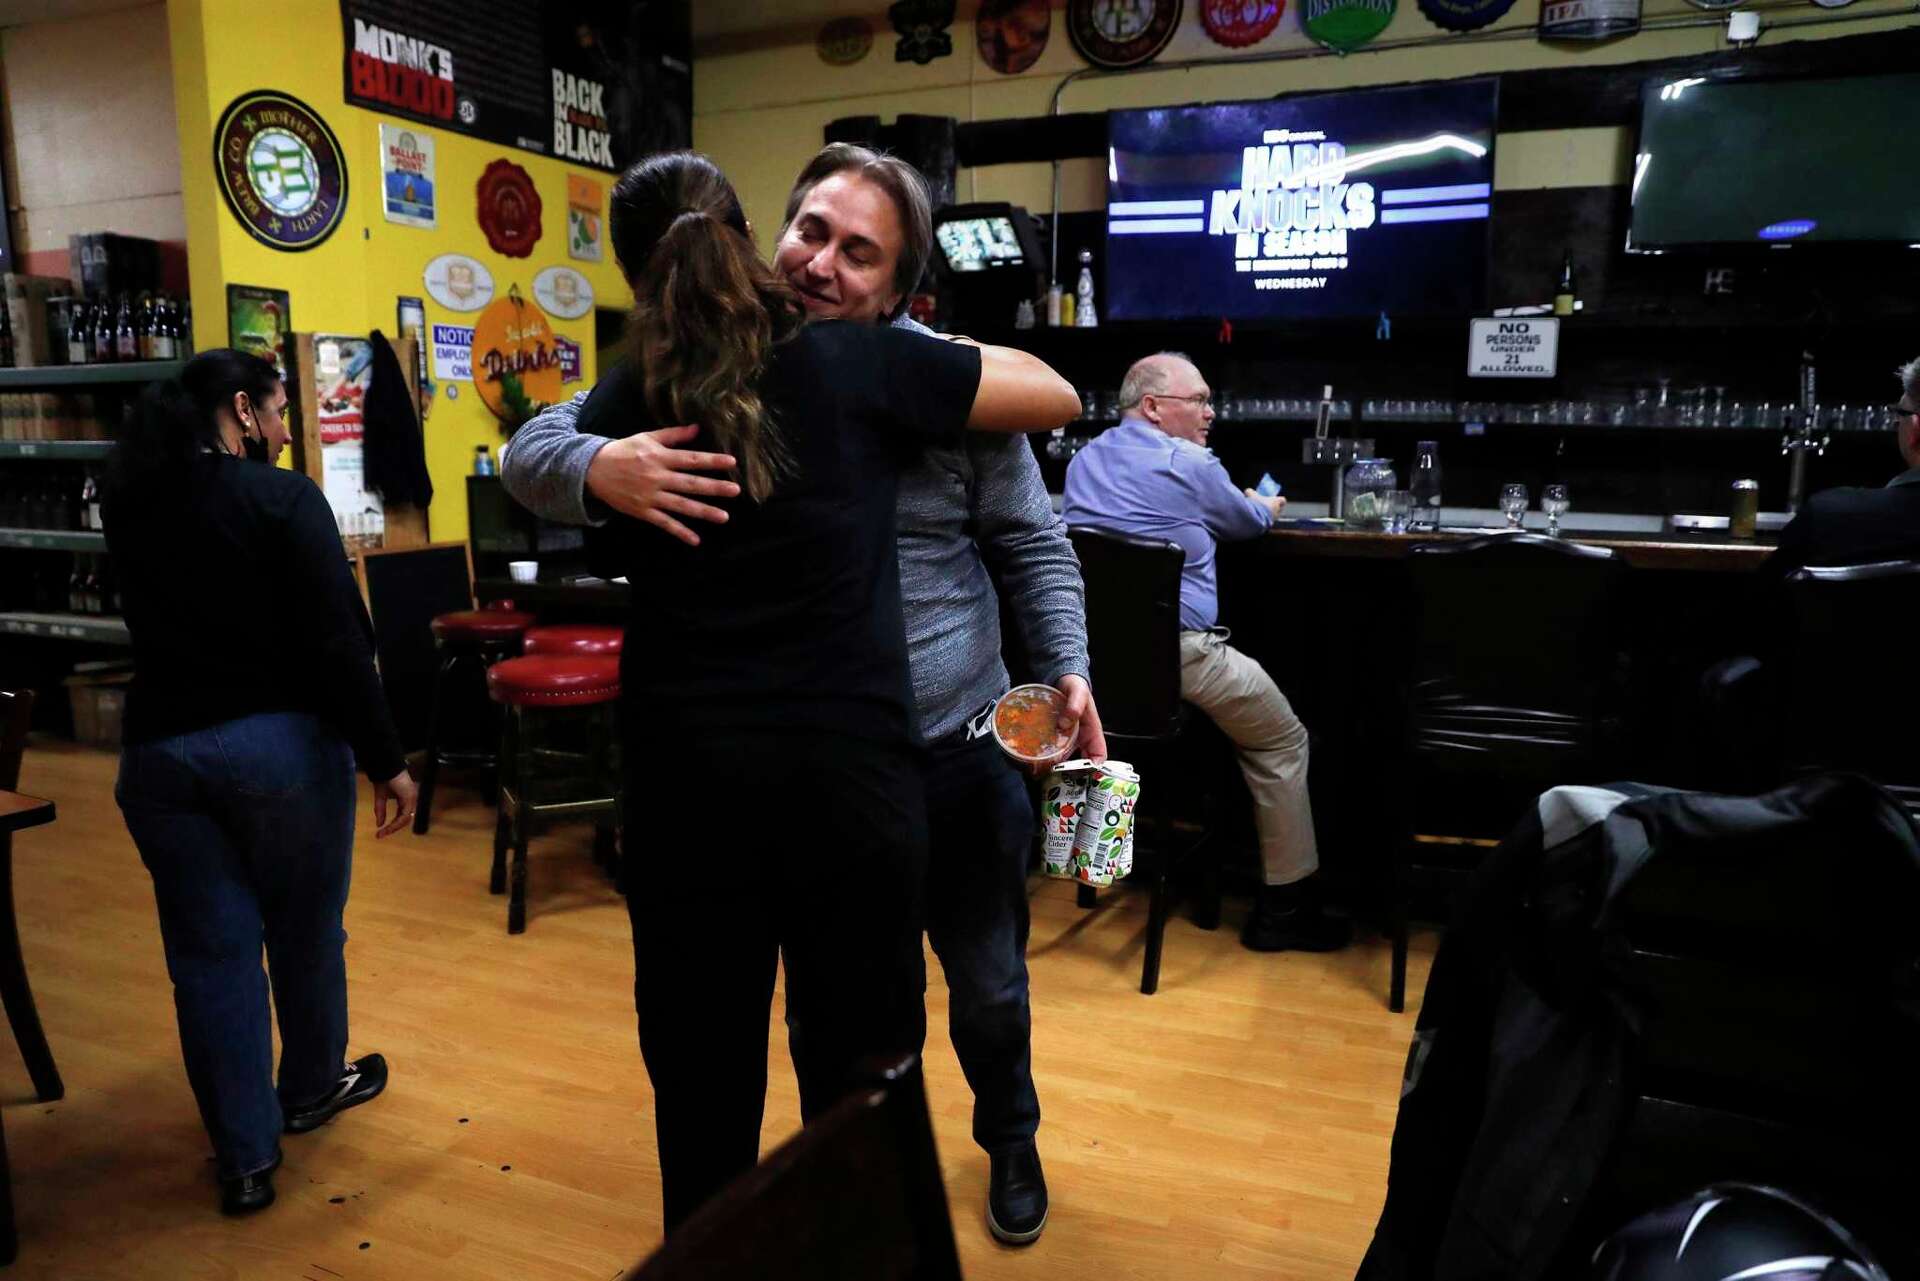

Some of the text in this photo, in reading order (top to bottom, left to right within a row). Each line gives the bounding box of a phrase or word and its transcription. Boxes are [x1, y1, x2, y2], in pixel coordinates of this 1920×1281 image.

[351, 50, 455, 120] BLOOD
[552, 67, 606, 118] BACK
[553, 101, 569, 123] IN
[553, 118, 615, 168] BLACK
[258, 109, 319, 145] MOTHER
[290, 198, 329, 233] EARTH
[1241, 142, 1346, 191] HARD
[231, 169, 261, 217] BREW
[1208, 182, 1376, 236] KNOCKS
[1263, 229, 1348, 257] SEASON
[1254, 277, 1328, 290] WEDNESDAY
[438, 328, 474, 345] NOTIC
[1499, 322, 1530, 334] NO
[1485, 334, 1541, 345] PERSONS
[436, 347, 471, 360] EMPLOY
[1504, 354, 1520, 365] 21
[451, 364, 473, 377] ONL
[1047, 832, 1074, 842] Sincere
[1047, 840, 1067, 848] Cider
